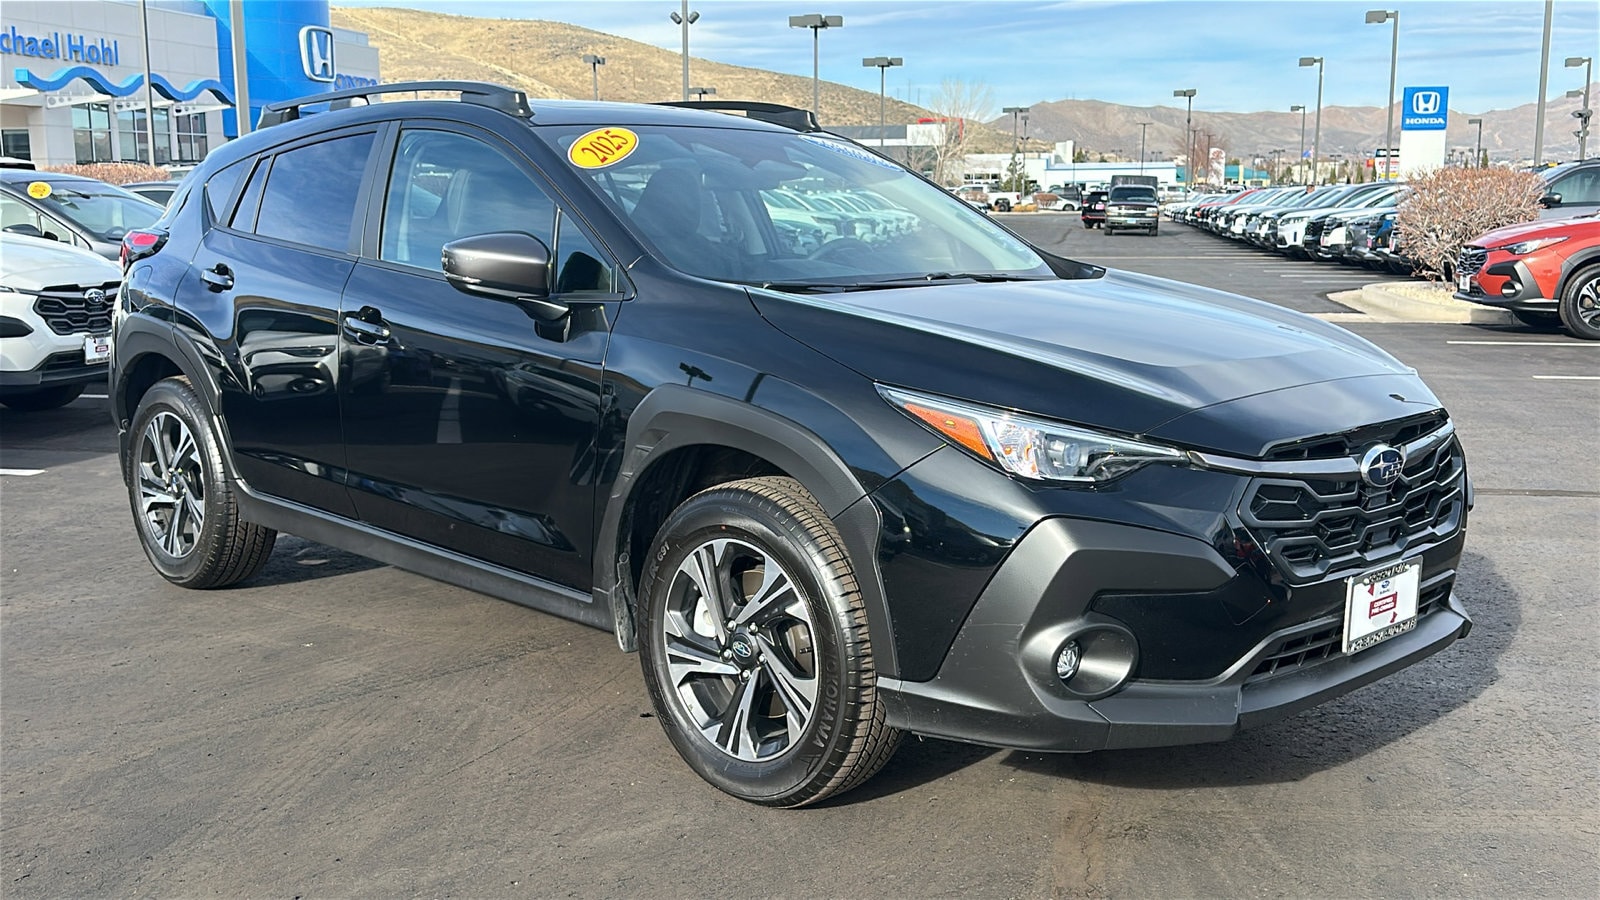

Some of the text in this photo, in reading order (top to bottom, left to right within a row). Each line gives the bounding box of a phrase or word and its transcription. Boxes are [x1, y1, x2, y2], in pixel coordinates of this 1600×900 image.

[0, 26, 119, 66] chael Hohl
[1405, 117, 1445, 125] HONDA
[580, 129, 629, 164] 2025
